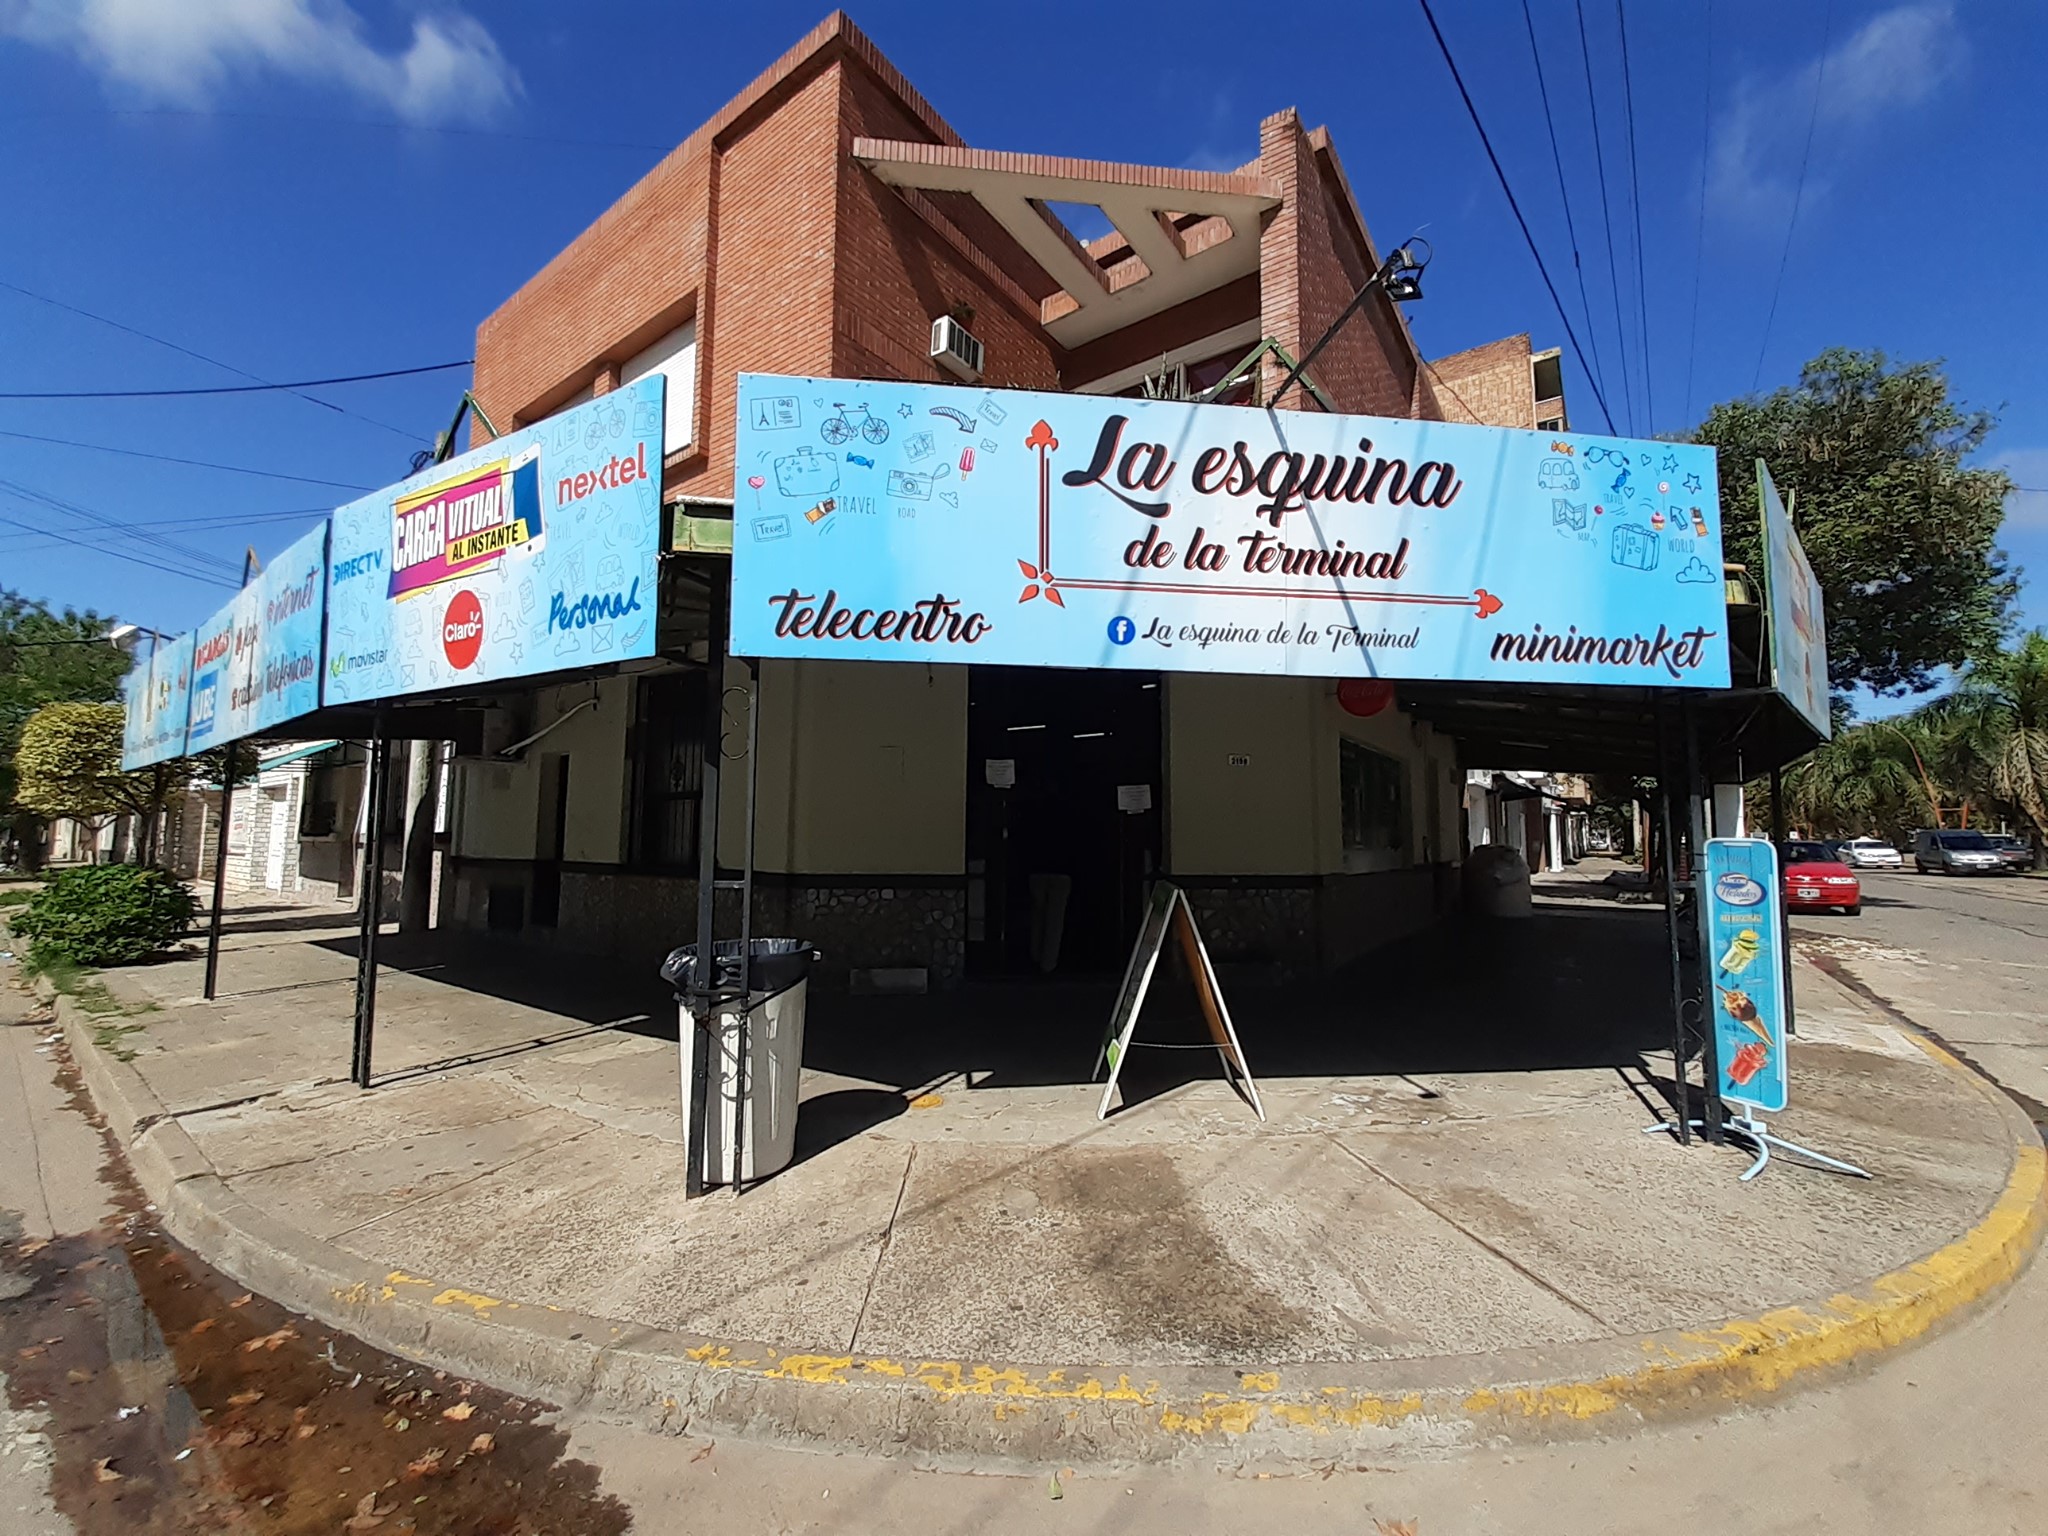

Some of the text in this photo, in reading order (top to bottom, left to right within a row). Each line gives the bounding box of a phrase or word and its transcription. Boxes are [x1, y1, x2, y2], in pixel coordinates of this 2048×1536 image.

[558, 442, 648, 504] nextel
[1062, 414, 1463, 527] La esquina
[393, 483, 503, 572] CARGA VITUAL
[837, 495, 877, 515] TRAVEL
[333, 548, 384, 586] DIRECTV
[452, 543, 466, 562] AL
[467, 522, 519, 557] INSTANTE
[1123, 523, 1411, 580] de la terminal
[445, 611, 482, 643] Claro
[548, 576, 641, 635] Personal
[768, 588, 993, 644] telecentro
[347, 650, 389, 670] movistar
[1141, 616, 1421, 653] La esquina de la Terminal
[1490, 622, 1718, 680] minimarket
